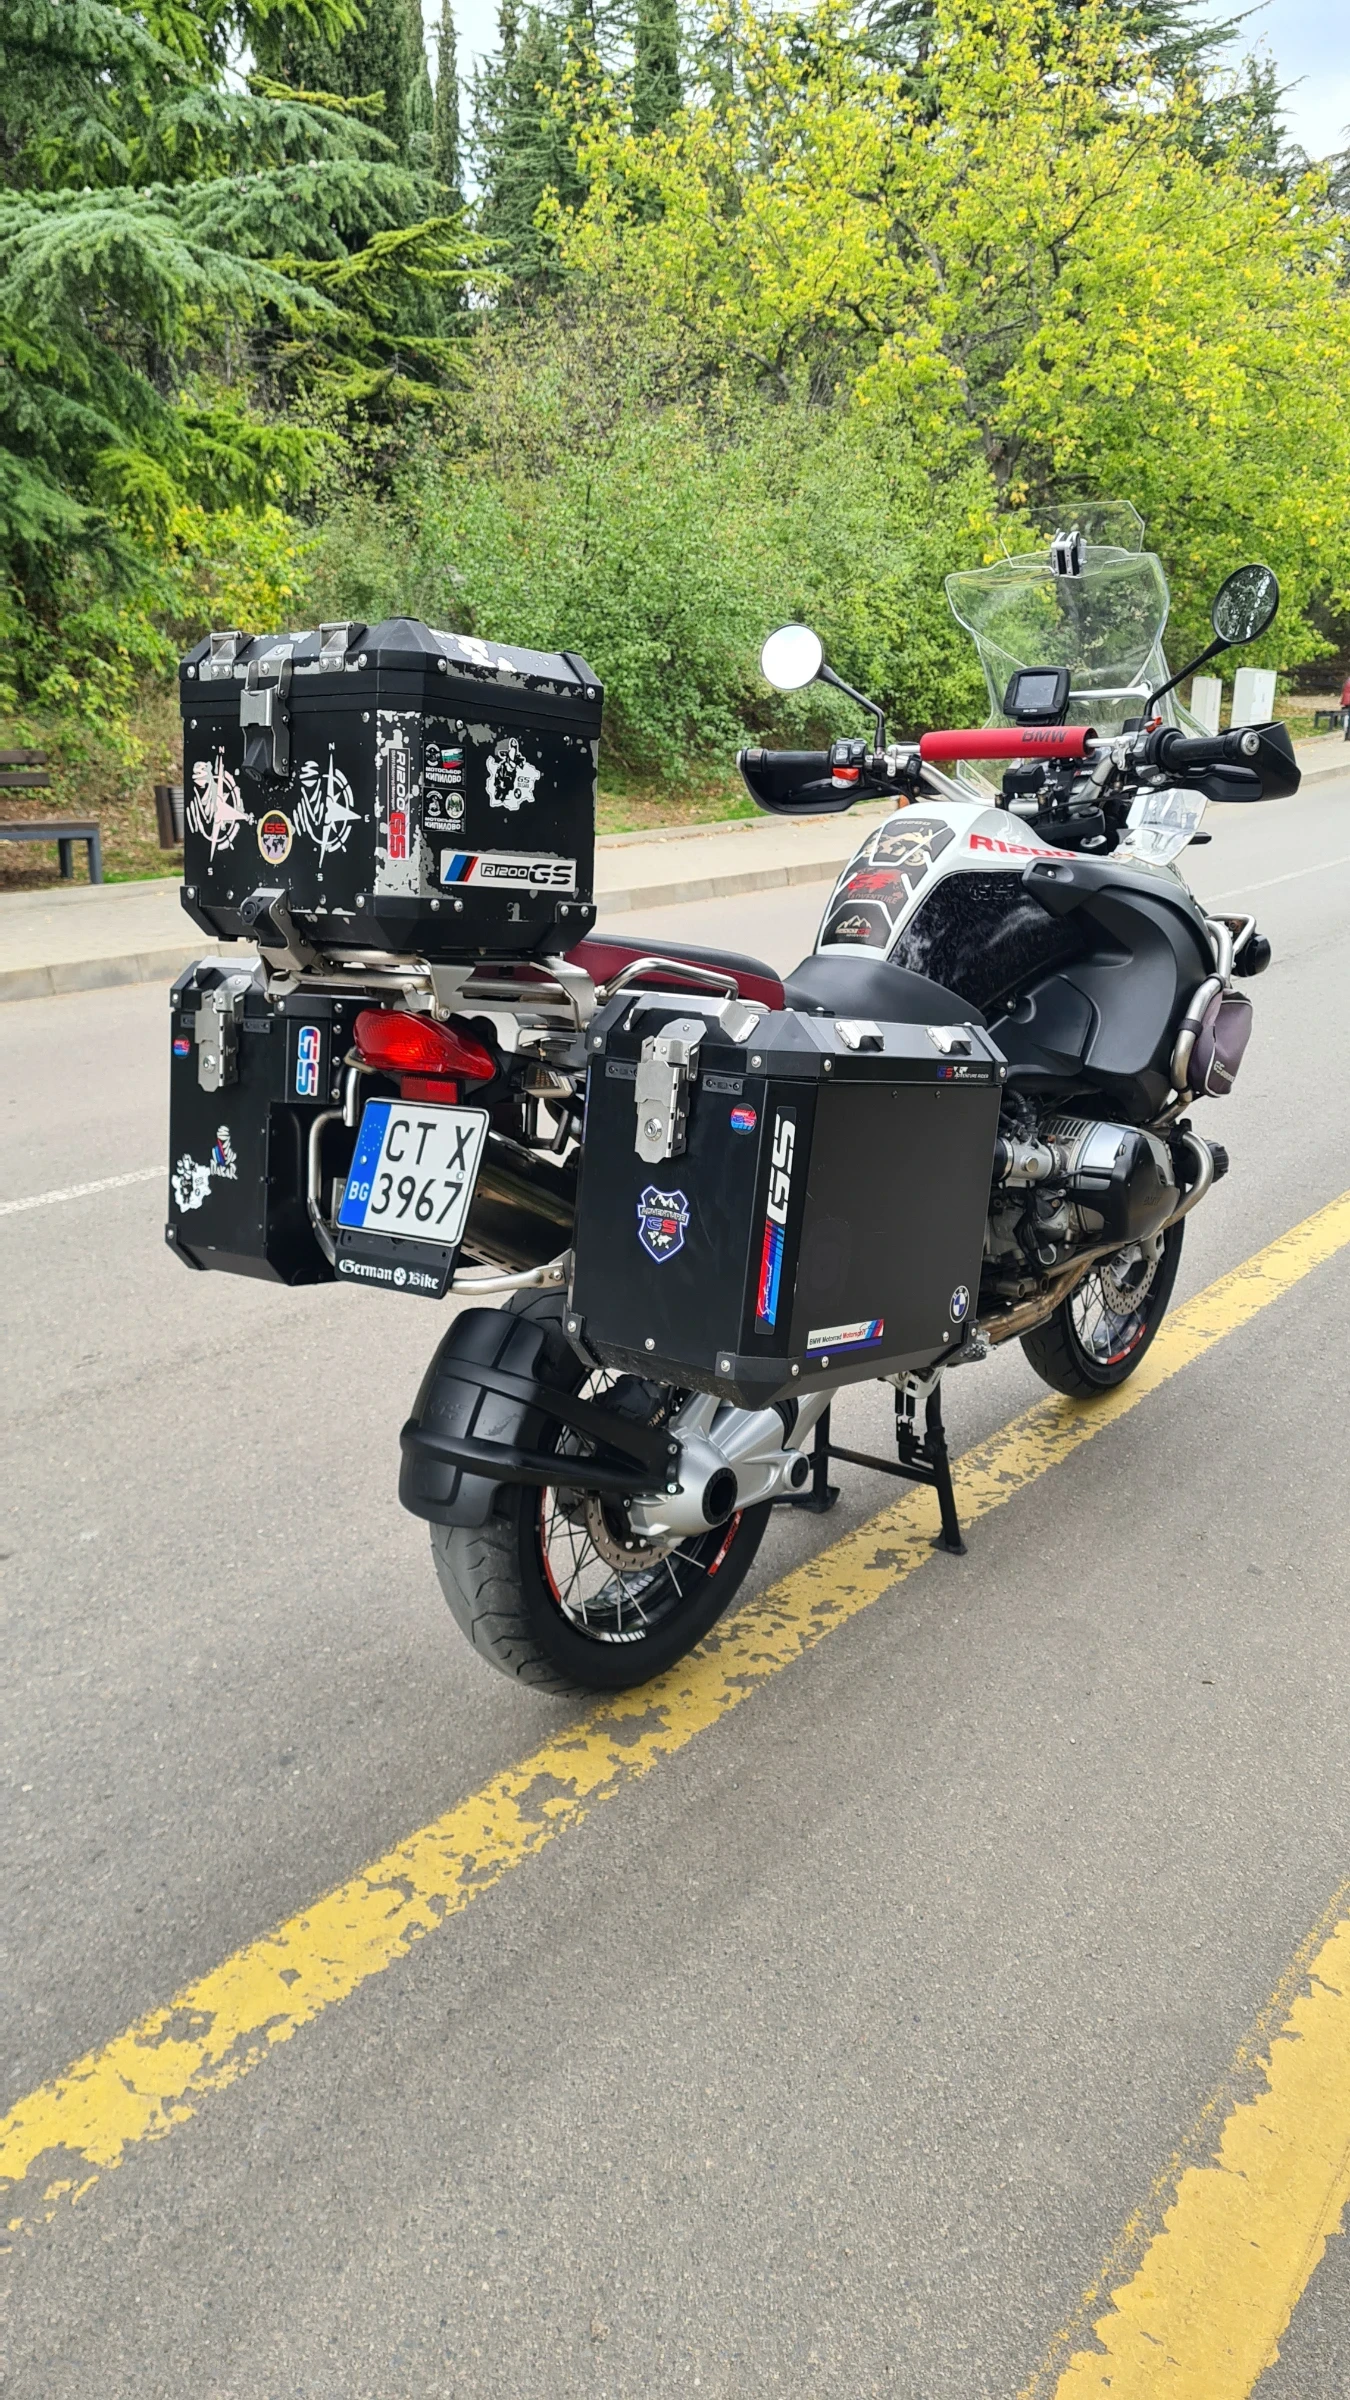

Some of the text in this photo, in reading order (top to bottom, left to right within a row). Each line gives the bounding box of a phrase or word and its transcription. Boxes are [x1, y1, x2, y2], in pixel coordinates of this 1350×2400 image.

[1022, 730, 1069, 743] BMW
[218, 746, 225, 754] N
[328, 742, 336, 750] N
[425, 772, 462, 784] КИПИЛОВО
[389, 751, 406, 858] R1200 GS
[364, 814, 370, 823] E
[424, 821, 462, 831] КИПИЛОВО
[264, 823, 286, 834] GS
[970, 834, 1078, 857] R1200
[207, 867, 214, 876] S
[316, 873, 324, 882] S
[529, 864, 573, 886] GS
[296, 1026, 321, 1096] GS
[937, 1066, 953, 1079] GS
[386, 1120, 476, 1171] CT X
[210, 1159, 238, 1180] DAKAR
[767, 1113, 796, 1225] GS
[348, 1180, 370, 1201] BG
[371, 1173, 463, 1224] 3967
[641, 1207, 687, 1222] ADVENTURE
[647, 1217, 678, 1233] GS
[339, 1259, 439, 1290] German Bike
[809, 1337, 822, 1345] BMW
[822, 1334, 842, 1343] Motorrad
